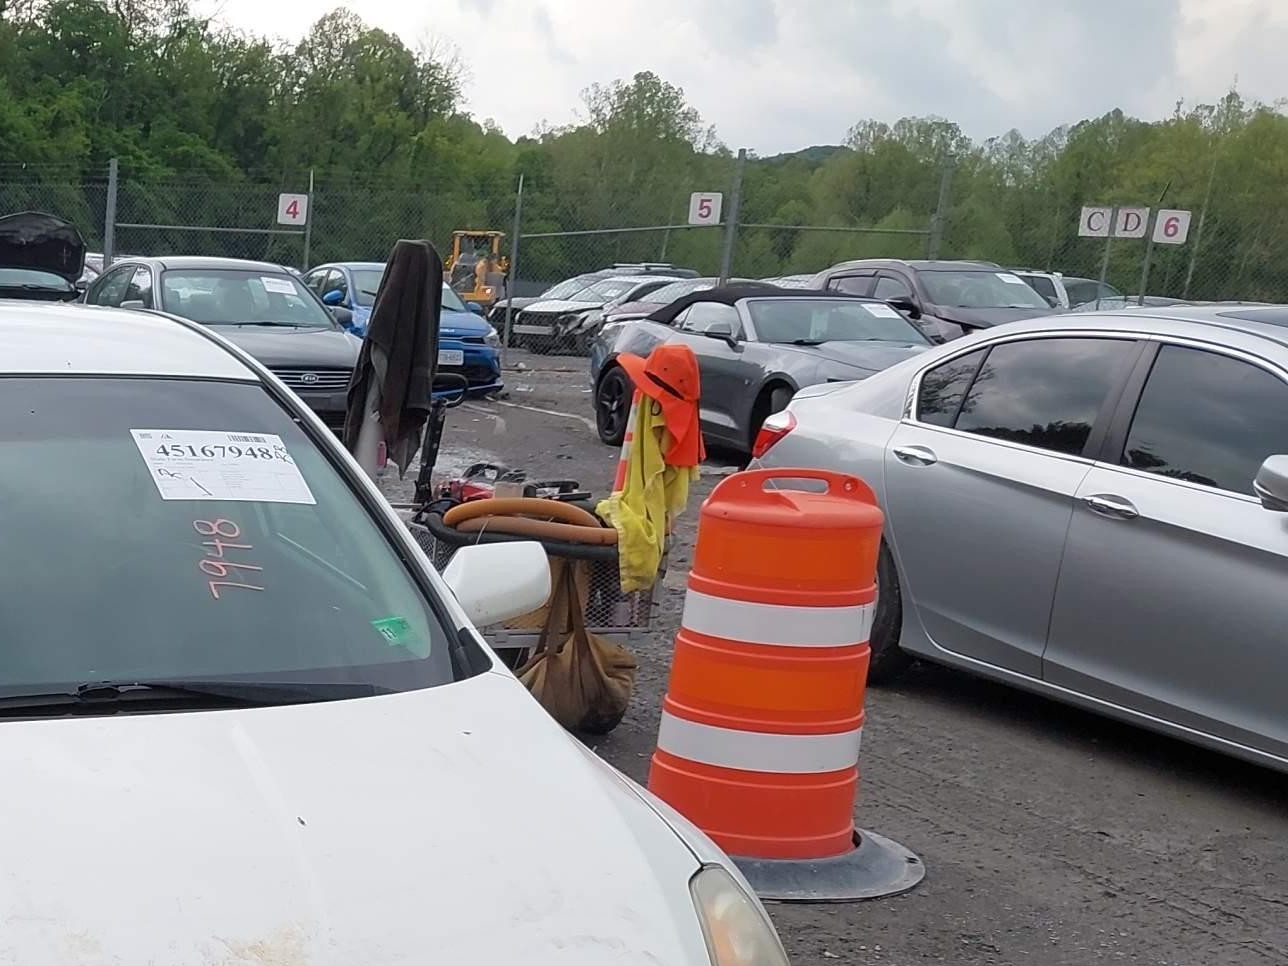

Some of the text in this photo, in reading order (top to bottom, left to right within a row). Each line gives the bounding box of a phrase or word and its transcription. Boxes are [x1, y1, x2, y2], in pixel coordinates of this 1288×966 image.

[285, 199, 300, 219] 4
[698, 198, 713, 219] 5
[1087, 211, 1105, 232] C
[1122, 212, 1142, 232] D
[1163, 216, 1180, 238] 6
[155, 443, 274, 460] 45167948
[193, 518, 264, 600] 7948
